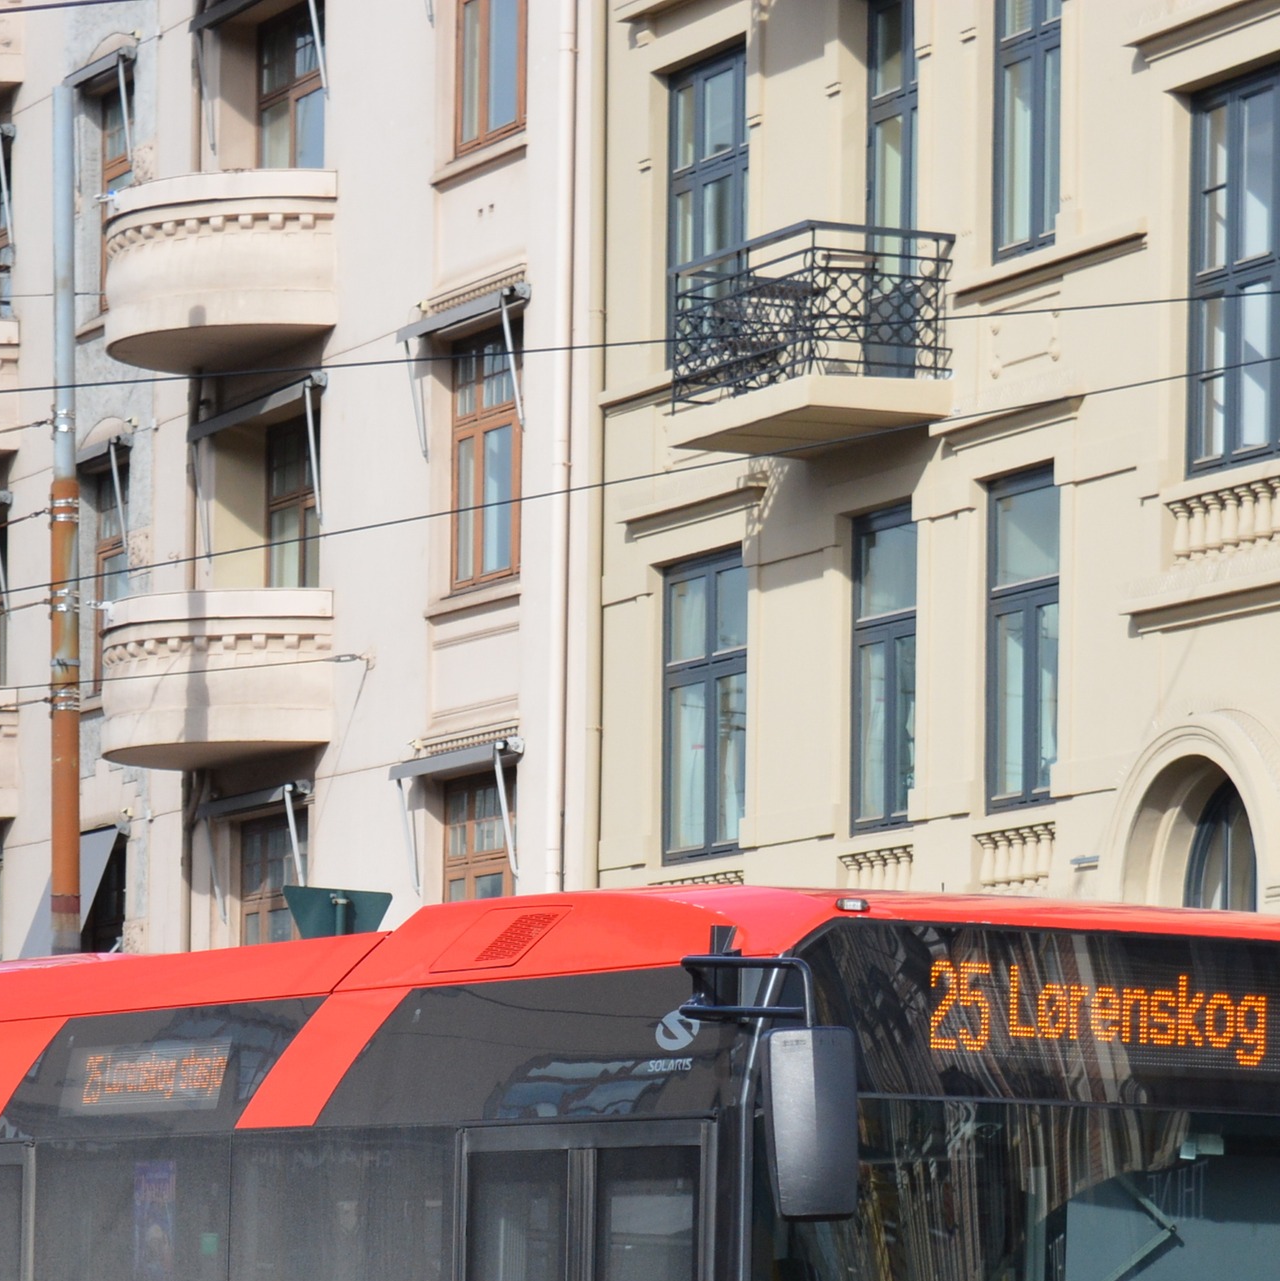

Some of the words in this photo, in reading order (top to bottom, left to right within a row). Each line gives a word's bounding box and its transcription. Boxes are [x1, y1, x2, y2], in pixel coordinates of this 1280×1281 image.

[929, 960, 990, 1051] 25
[1009, 964, 1267, 1067] Lørenskog
[647, 1058, 693, 1073] SOLARIS
